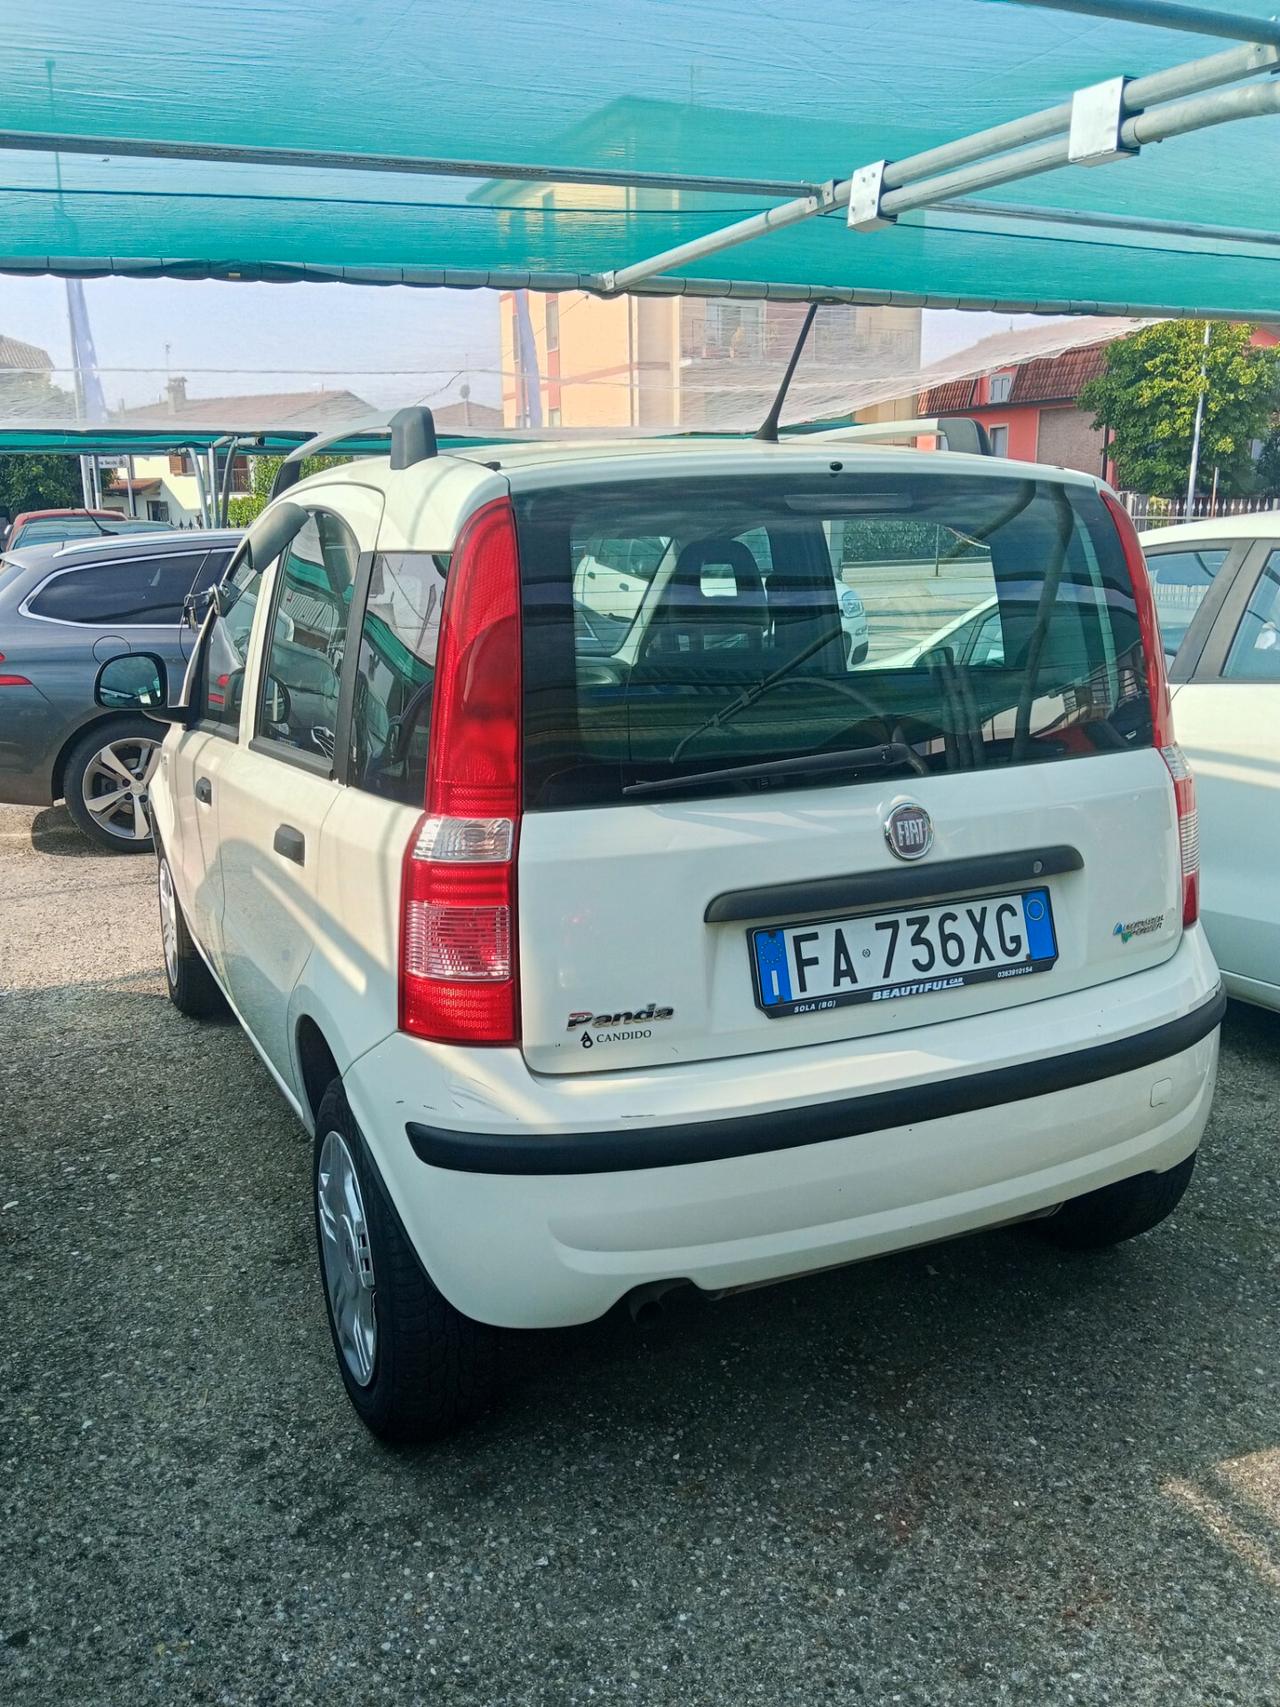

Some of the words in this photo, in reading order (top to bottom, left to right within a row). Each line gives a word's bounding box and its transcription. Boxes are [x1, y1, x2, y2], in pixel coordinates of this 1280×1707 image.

[896, 818, 924, 847] FIAT
[793, 928, 858, 993] FA
[875, 903, 1022, 979] 736XG
[871, 979, 964, 1001] BEAUTIFUL
[949, 977, 964, 985] CAR
[566, 1002, 675, 1032] Panda
[818, 999, 836, 1011] (BG)
[596, 1029, 652, 1043] CANDIDO
